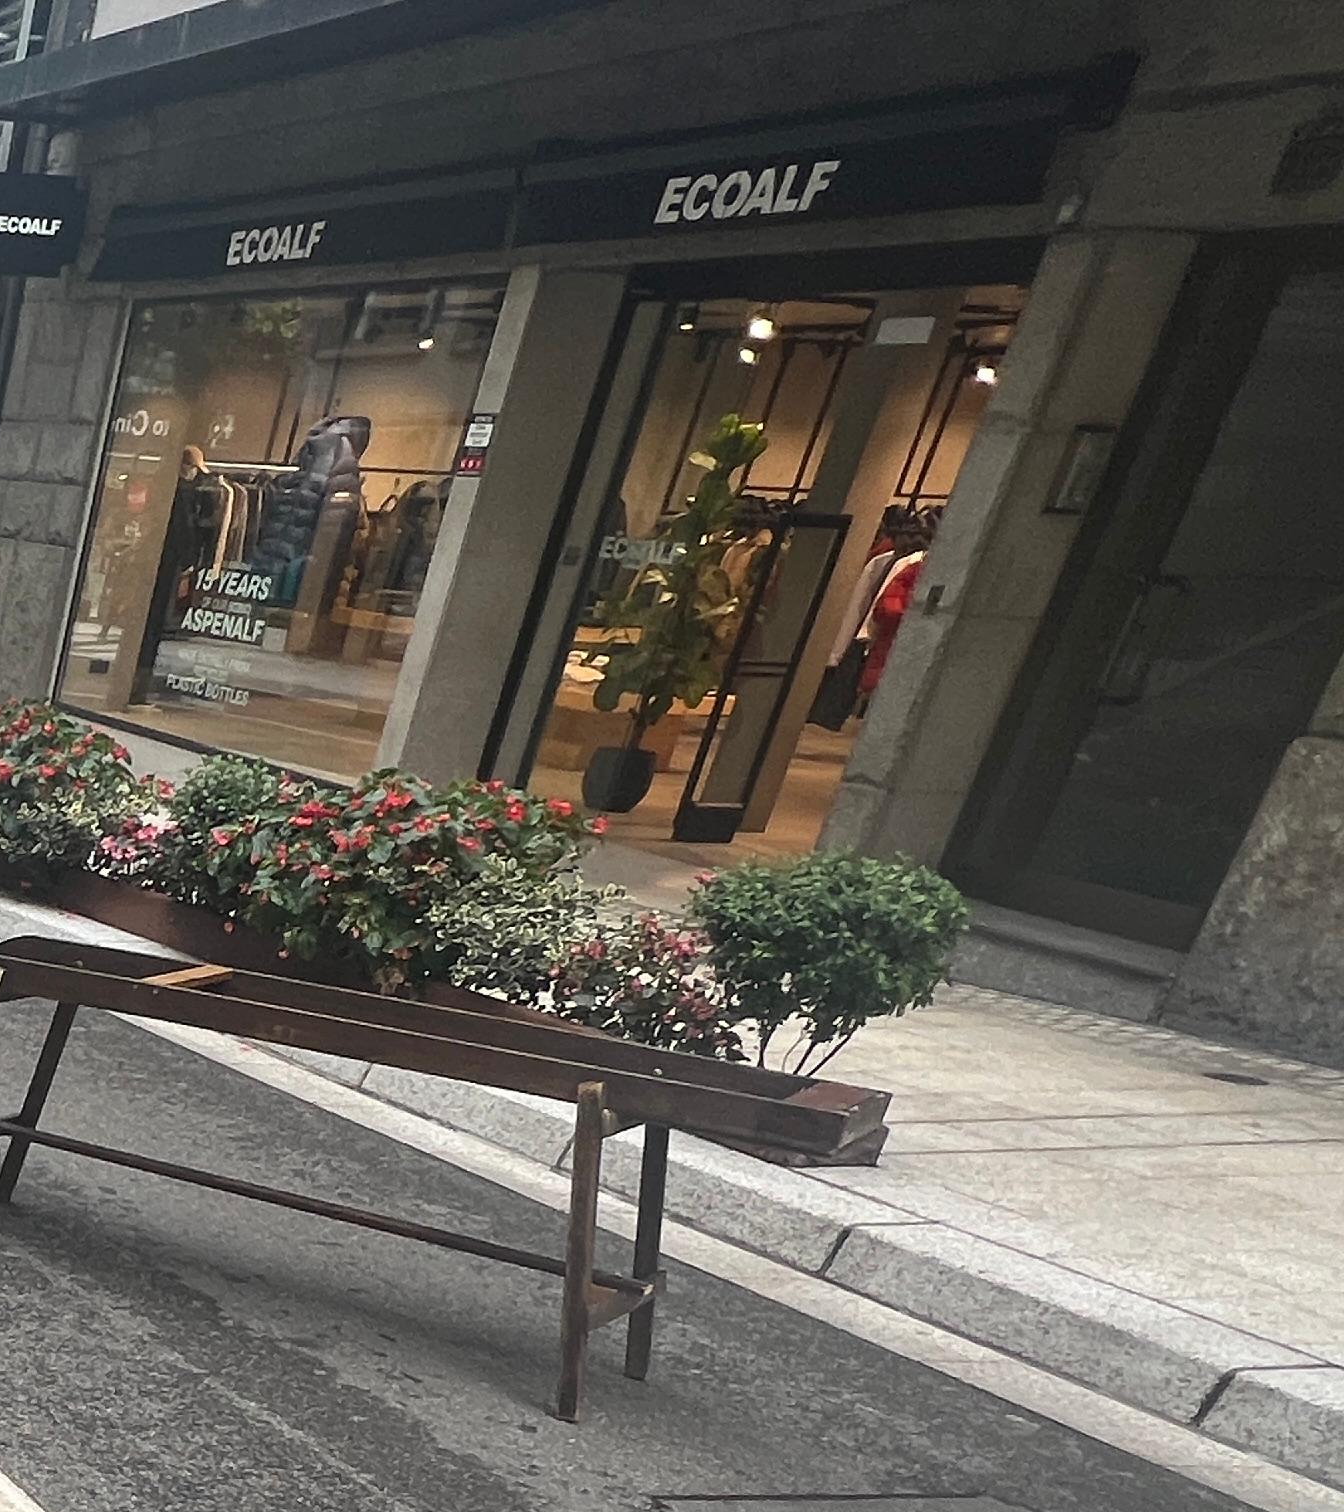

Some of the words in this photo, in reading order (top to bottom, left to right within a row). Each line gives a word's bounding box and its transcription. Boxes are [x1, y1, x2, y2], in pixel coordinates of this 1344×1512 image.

[653, 160, 841, 225] ECOALF
[225, 220, 328, 268] ECOALF
[195, 567, 217, 592] 15
[217, 570, 272, 601] YEARS
[180, 606, 266, 642] ASPENALF
